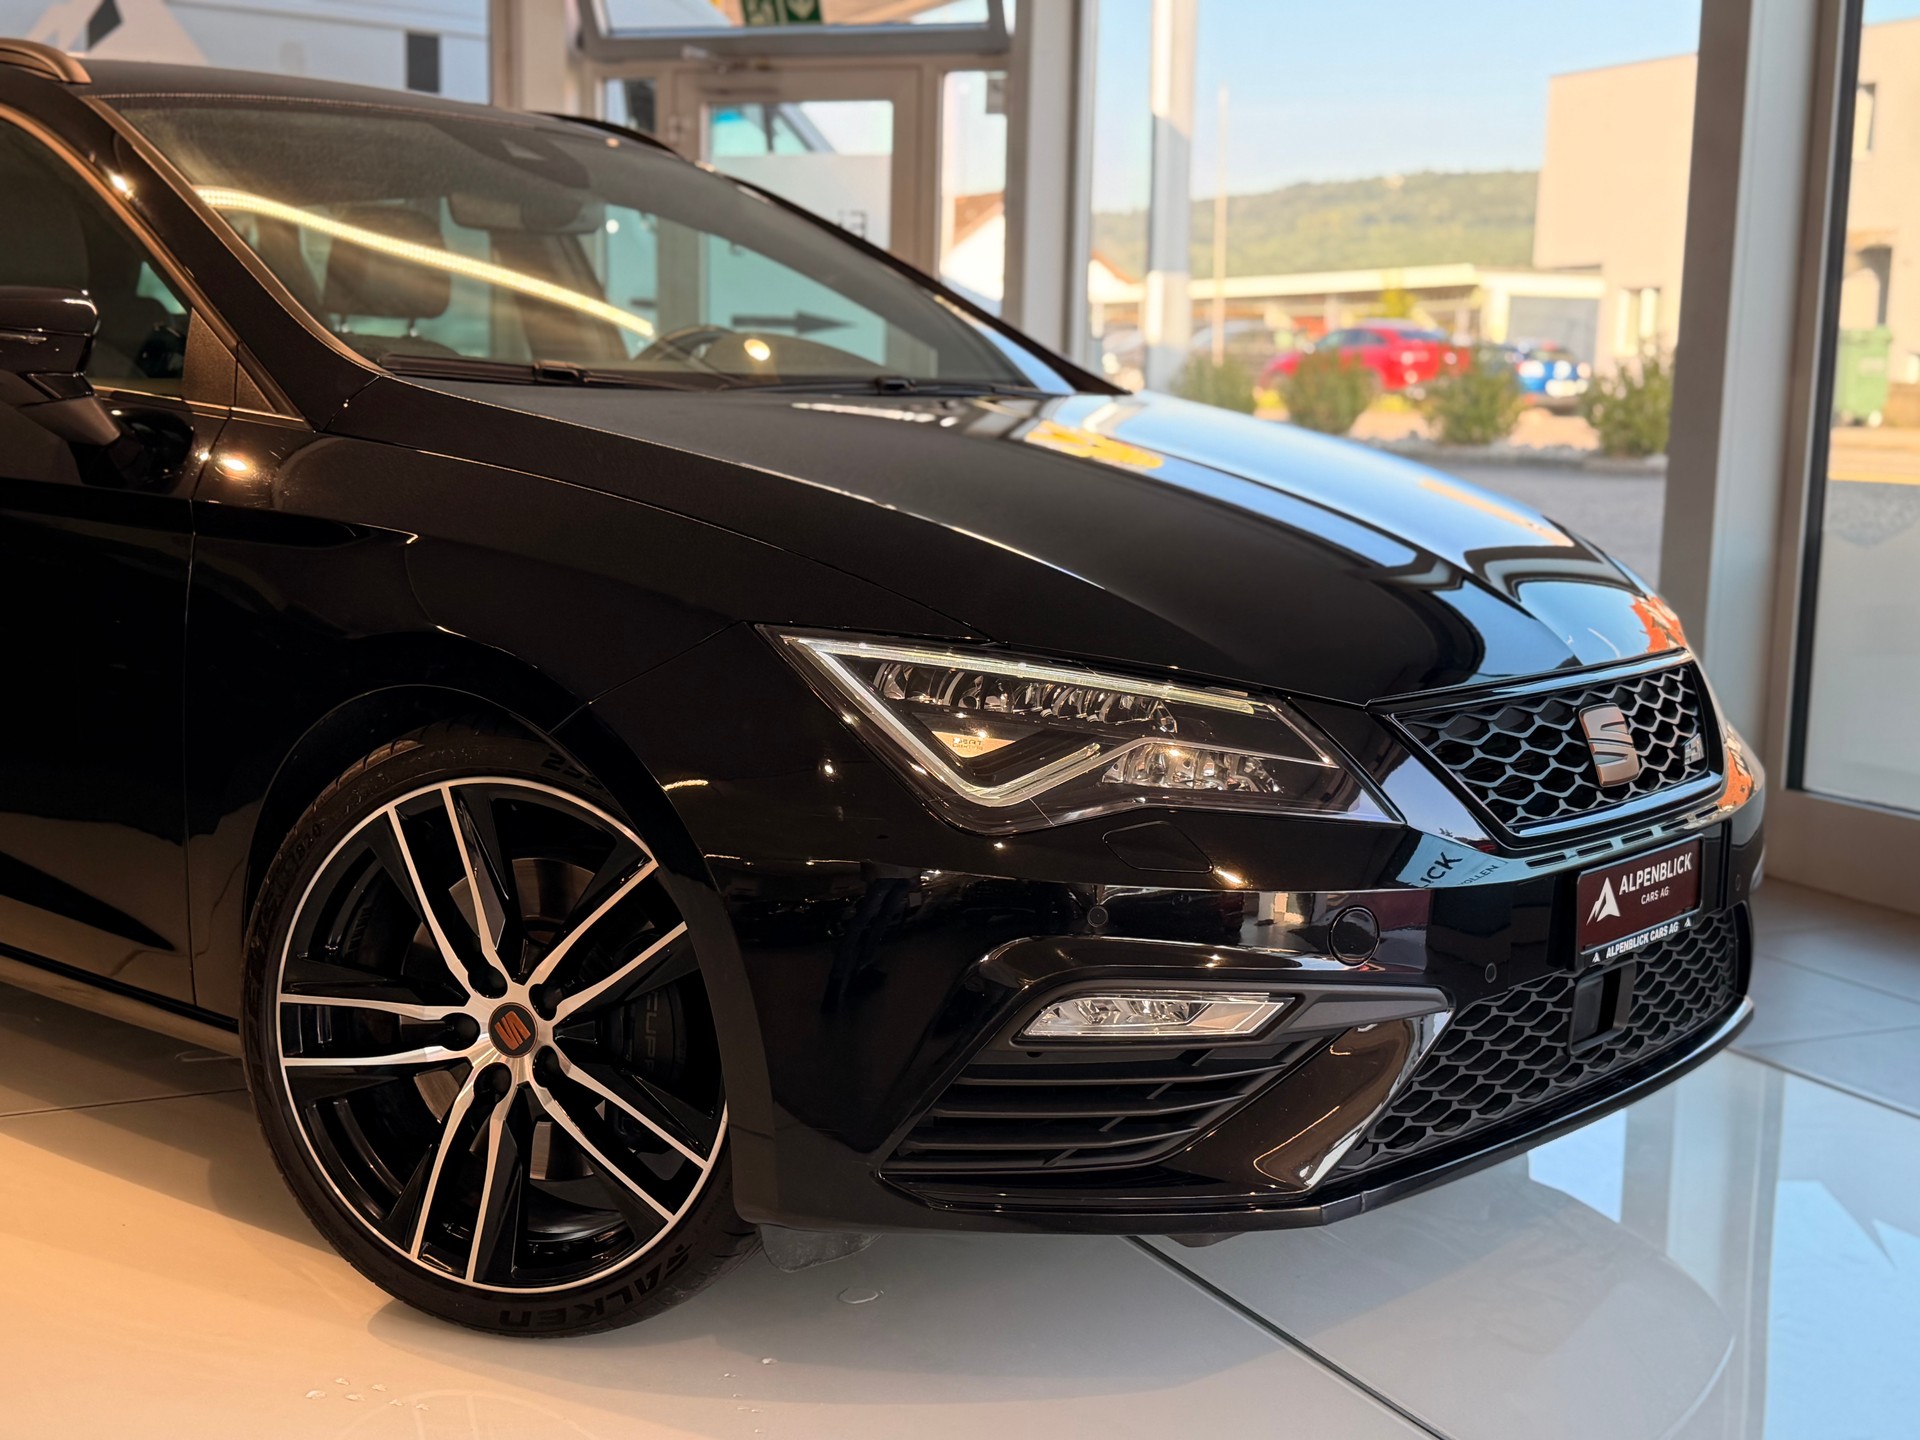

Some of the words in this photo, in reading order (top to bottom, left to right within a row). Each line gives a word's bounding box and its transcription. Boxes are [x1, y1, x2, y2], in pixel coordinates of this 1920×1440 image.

[1618, 851, 1693, 896] ALPENBLICK
[1640, 889, 1660, 905] CARS
[1659, 885, 1671, 898] AG
[1605, 931, 1650, 959] ALPENBLICK
[1649, 925, 1669, 942] CARS
[1668, 921, 1680, 935] AG
